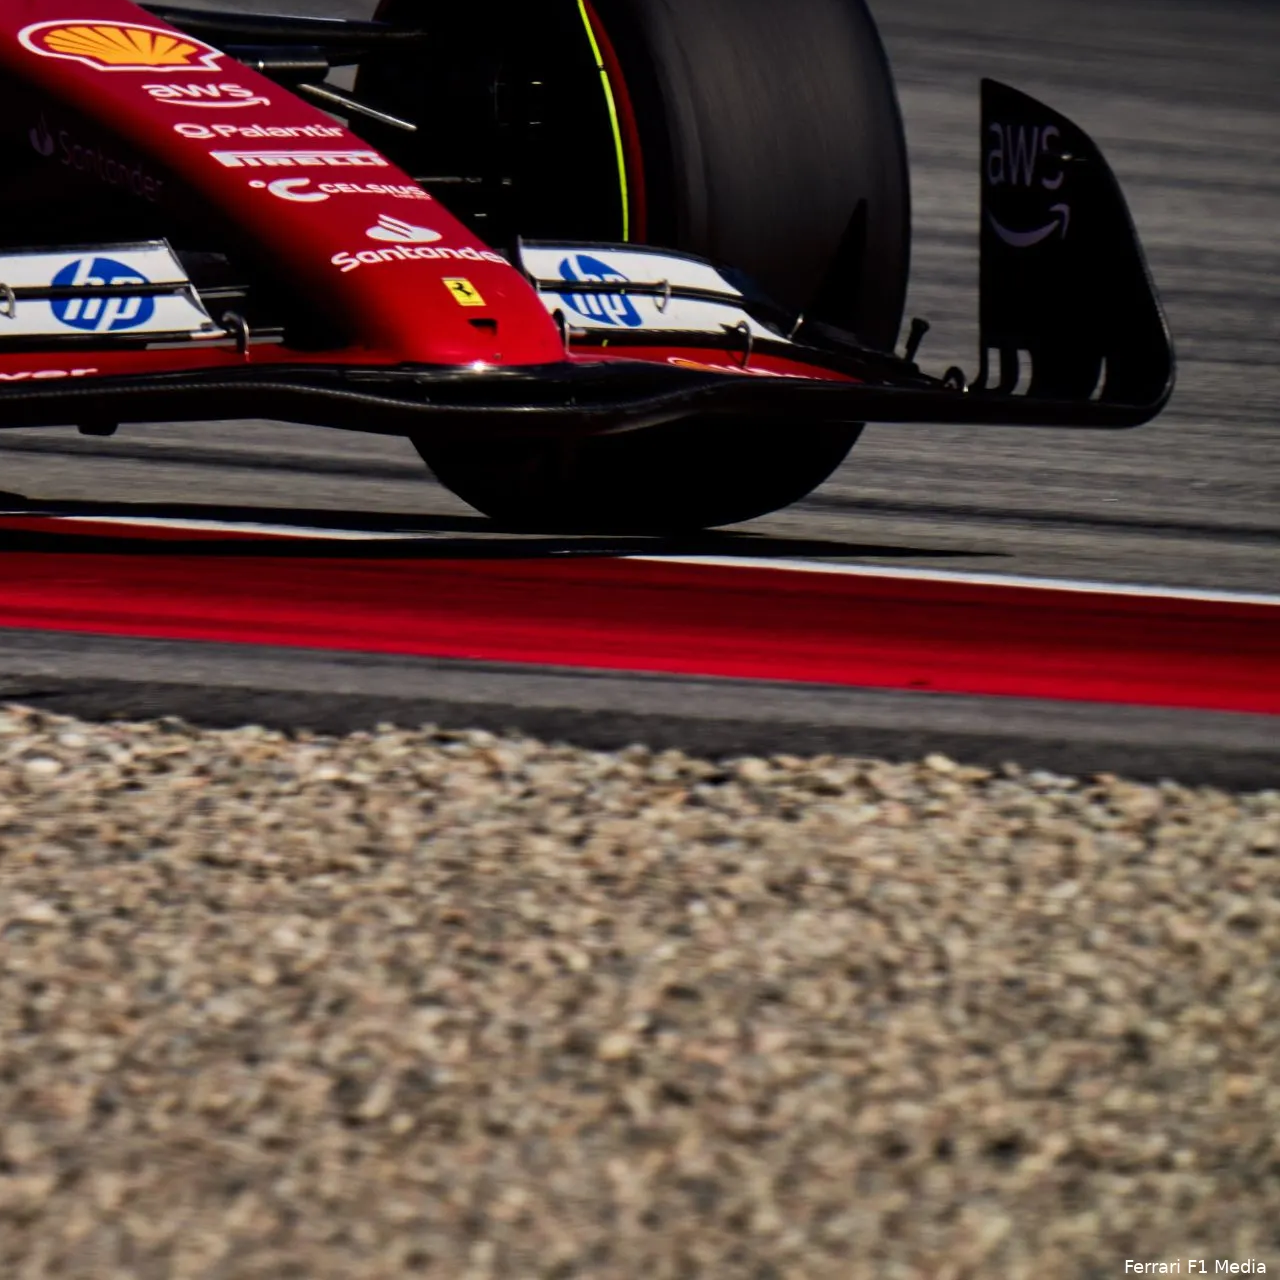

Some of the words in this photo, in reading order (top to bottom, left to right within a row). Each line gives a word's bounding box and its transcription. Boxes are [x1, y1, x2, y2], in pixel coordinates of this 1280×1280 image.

[141, 82, 255, 98] aws
[209, 122, 344, 138] Palantir
[208, 149, 390, 168] PIRELLI
[987, 121, 1066, 191] aws
[317, 183, 430, 199] CELSIUS
[62, 258, 140, 331] hp
